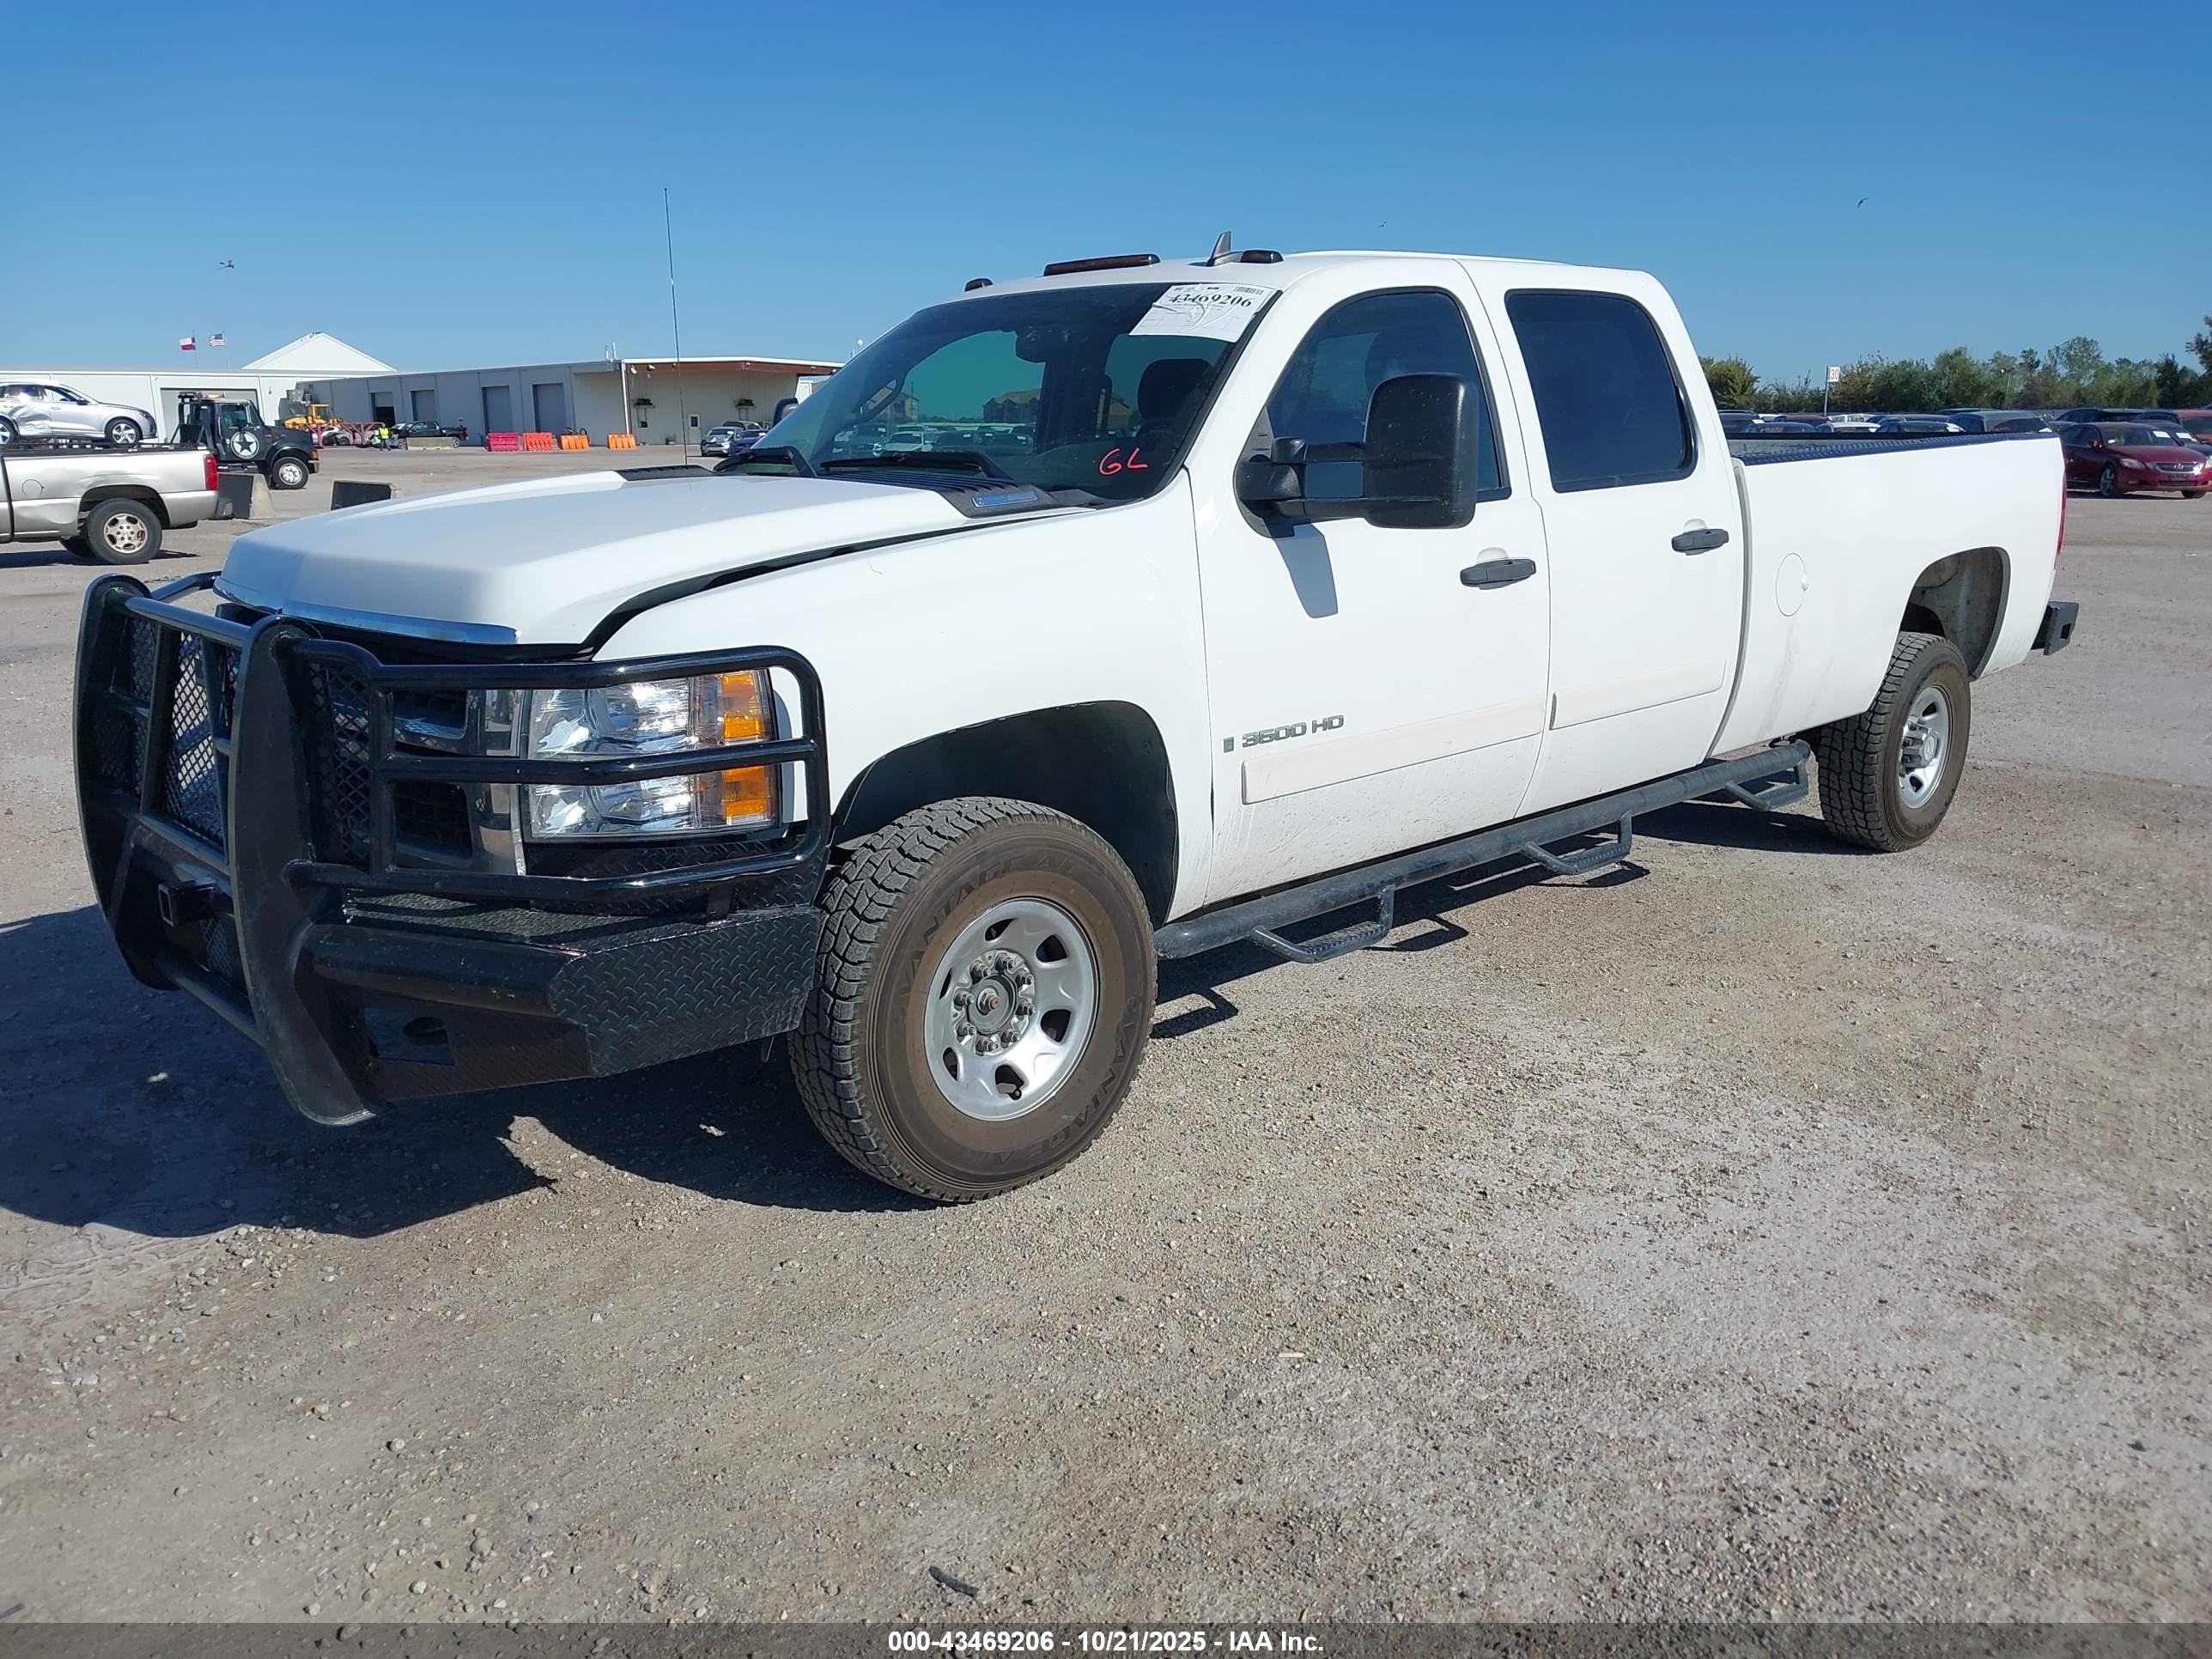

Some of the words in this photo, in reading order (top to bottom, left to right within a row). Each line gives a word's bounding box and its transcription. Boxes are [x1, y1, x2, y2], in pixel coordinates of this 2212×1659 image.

[1169, 294, 1255, 307] 43469206
[1242, 722, 1307, 748] 3500
[1311, 714, 1345, 733] HD
